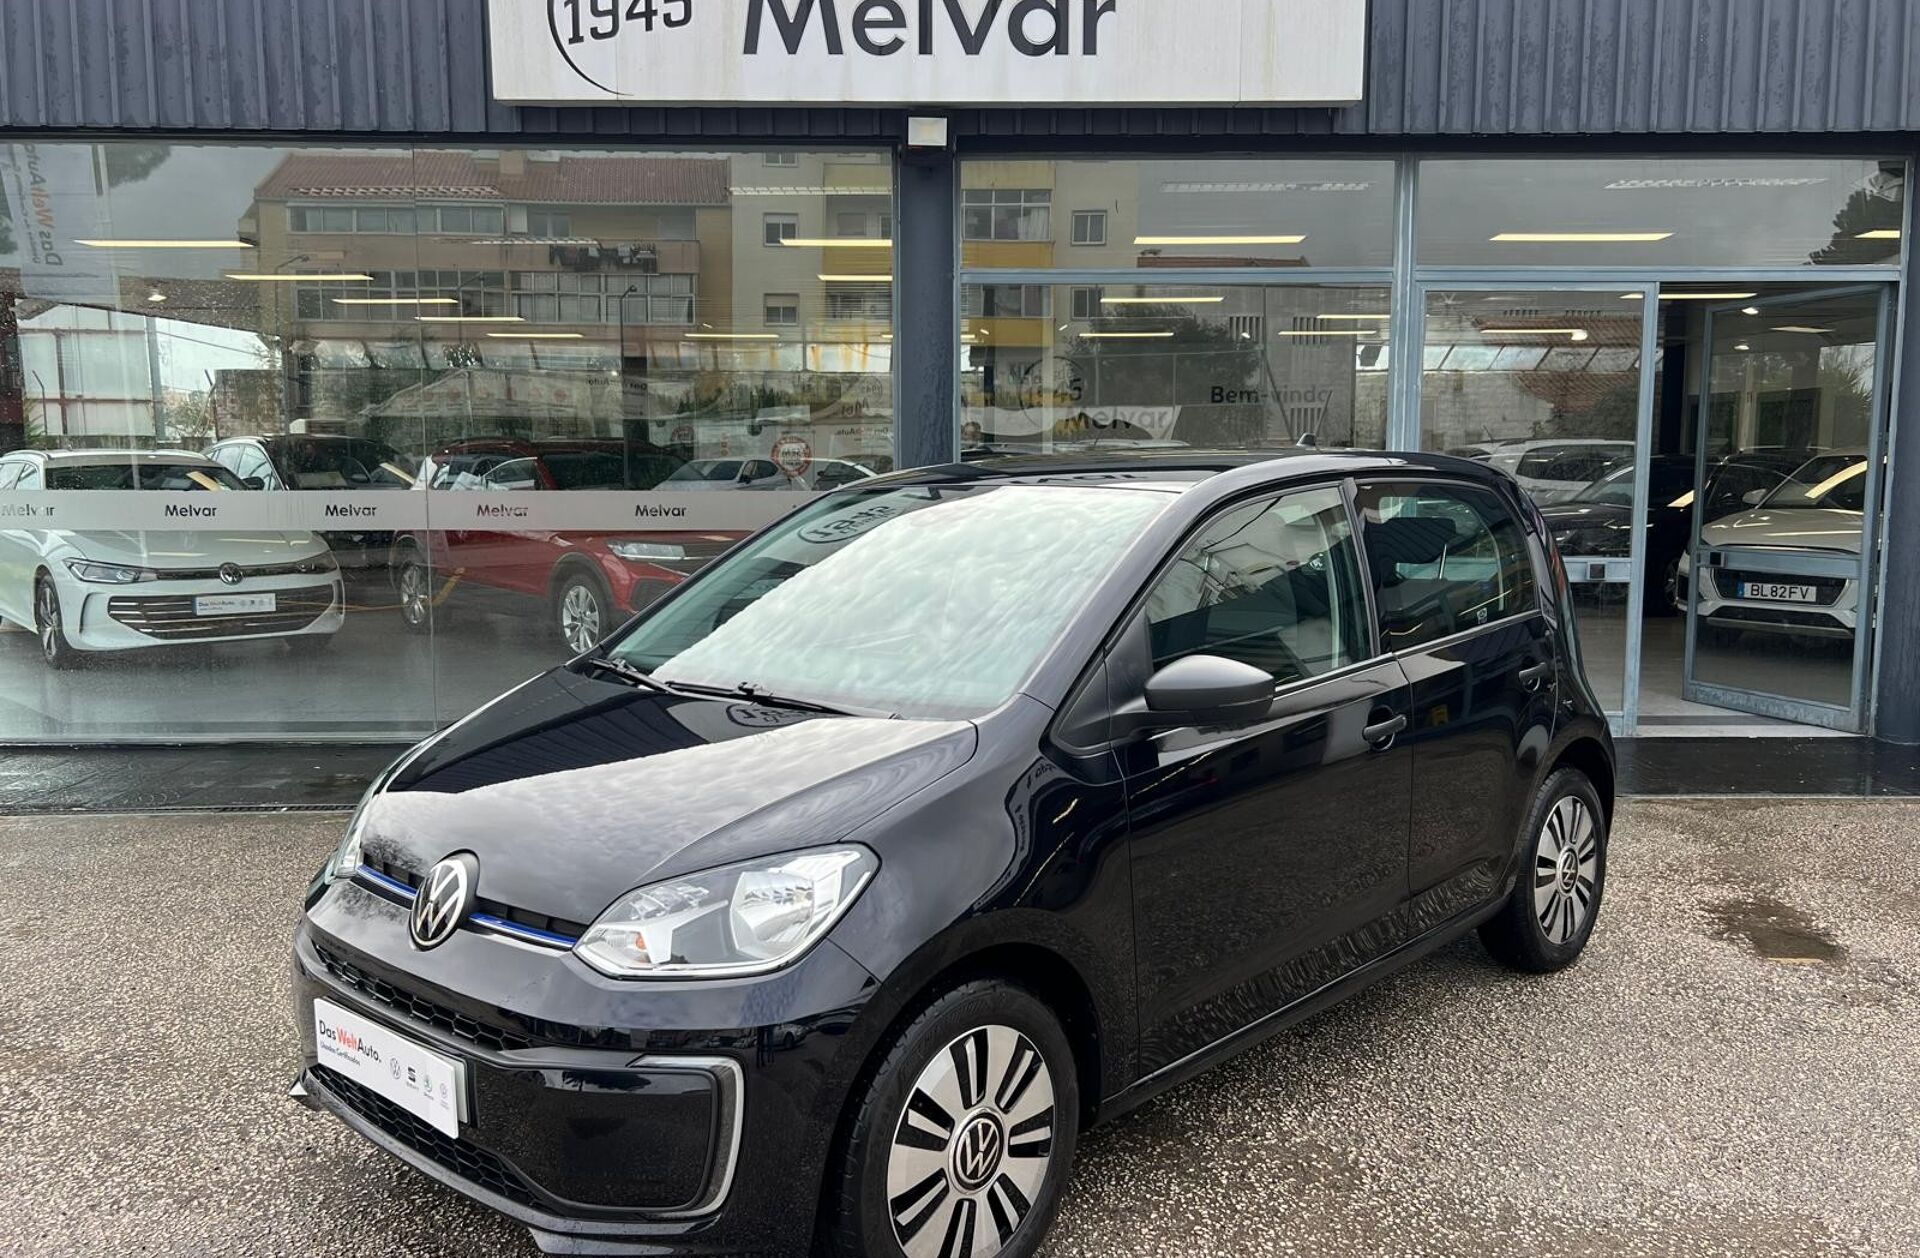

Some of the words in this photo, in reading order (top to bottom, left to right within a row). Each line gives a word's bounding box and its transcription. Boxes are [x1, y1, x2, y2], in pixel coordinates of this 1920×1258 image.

[564, 0, 692, 44] 1945
[743, 0, 1116, 56] Melvar
[165, 504, 217, 517] Melvar
[325, 504, 377, 517] Melvar
[476, 504, 528, 517] Melvar
[634, 504, 687, 517] Melvar
[1750, 584, 1809, 599] BL82FV
